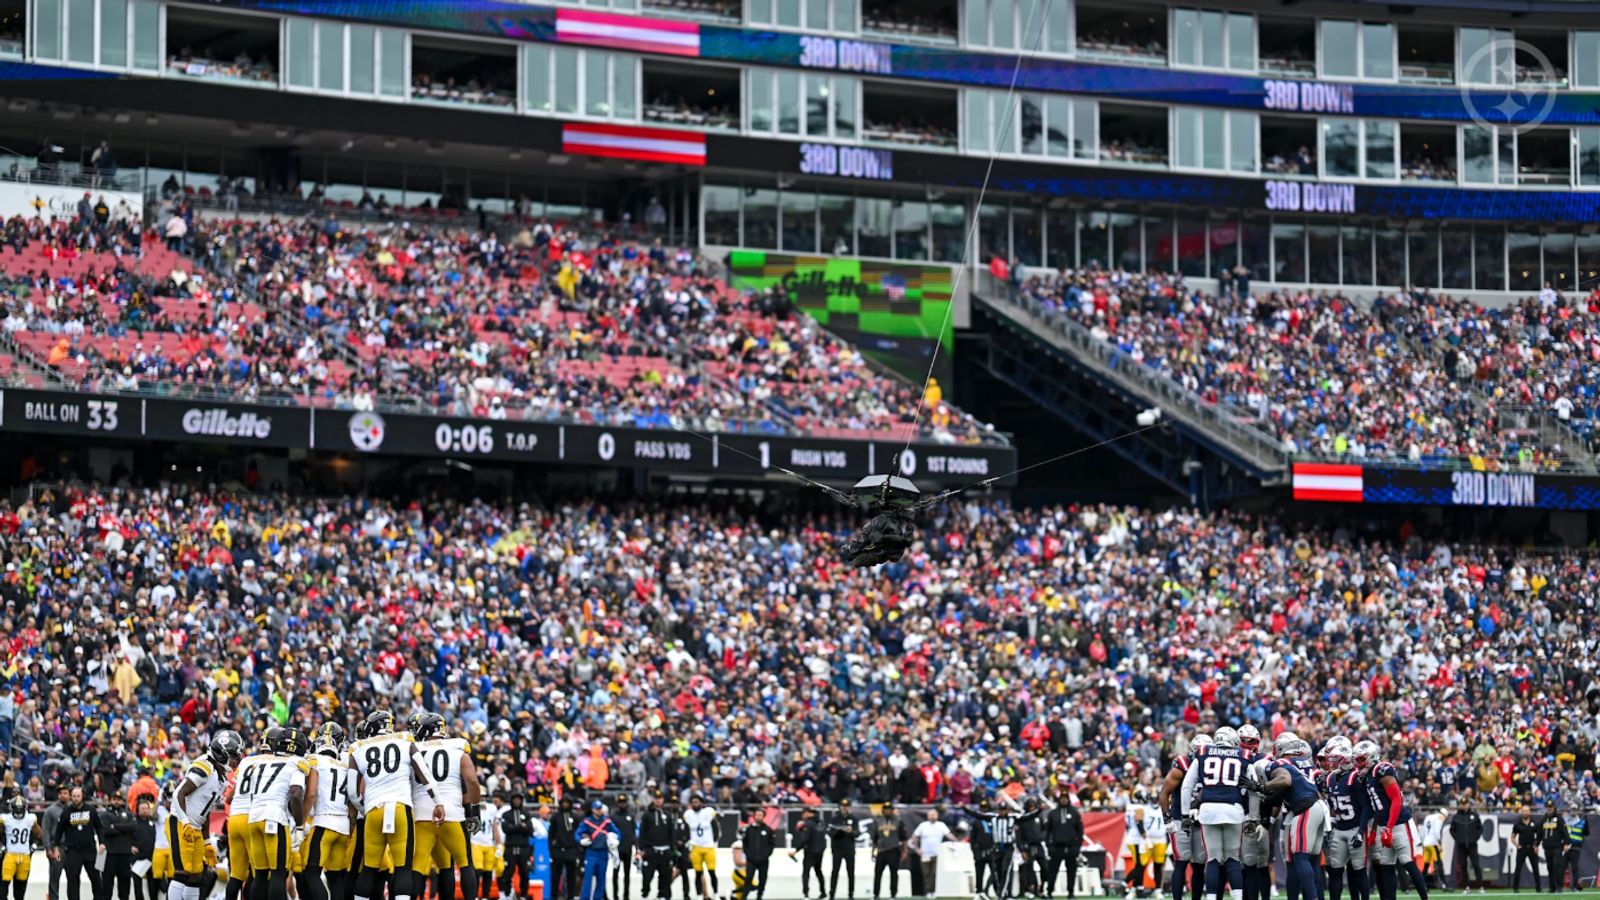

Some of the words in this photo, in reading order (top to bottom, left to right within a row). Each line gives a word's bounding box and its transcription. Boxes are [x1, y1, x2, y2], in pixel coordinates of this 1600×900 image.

[800, 37, 836, 68] 3RD
[1264, 80, 1299, 110] 3RD
[1301, 82, 1354, 113] DOWN
[800, 143, 836, 175] 3RD
[1265, 180, 1300, 210] 3RD
[1302, 182, 1355, 213] DOWN
[782, 271, 868, 298] Gillette
[25, 402, 56, 421] BALL
[60, 404, 79, 422] ON
[87, 400, 118, 430] 33
[182, 409, 271, 438] Gillette
[435, 423, 493, 453] 0:06
[506, 433, 537, 451] T.O.P
[598, 433, 615, 460] 0
[635, 440, 665, 459] PASS
[667, 442, 691, 460] YDS
[759, 441, 770, 468] 1
[822, 451, 847, 468] YDS
[900, 449, 917, 475] 0
[927, 456, 946, 473] 1ST
[947, 458, 988, 475] DOWNS
[1451, 472, 1484, 504] 3RD
[1487, 475, 1535, 507] DOWN
[366, 743, 400, 778] 80
[1208, 746, 1240, 757] BARMORE
[330, 768, 348, 804] 14
[1203, 757, 1241, 786] 90
[10, 828, 29, 845] 30
